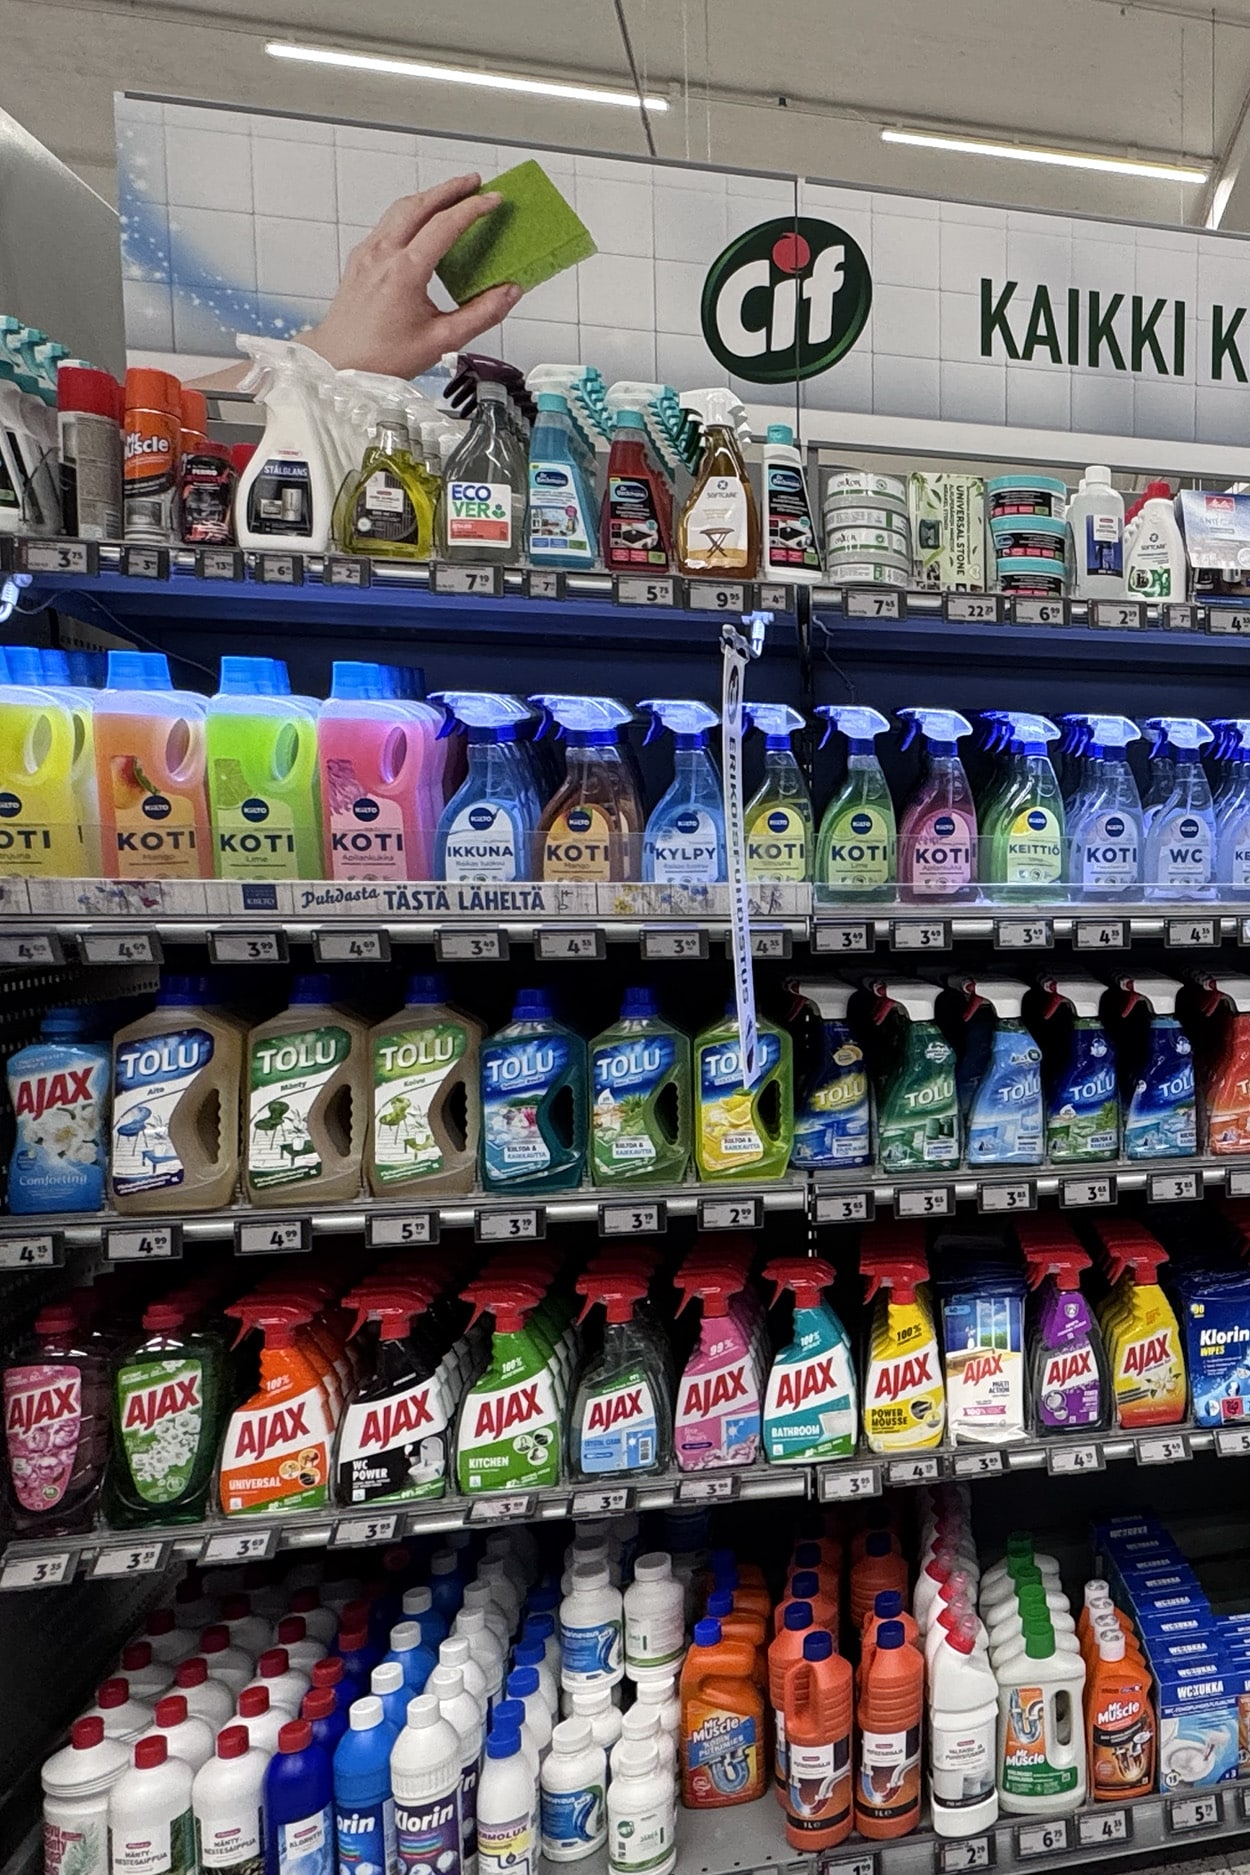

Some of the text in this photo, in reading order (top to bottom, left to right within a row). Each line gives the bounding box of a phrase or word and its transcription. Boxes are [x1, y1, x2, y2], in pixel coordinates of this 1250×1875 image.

[716, 240, 845, 357] Cif
[981, 278, 1185, 376] KAIKKI
[451, 485, 491, 500] ECO
[453, 502, 491, 518] VER
[955, 485, 966, 576] UNIVERSAL STONE
[0, 831, 51, 849] OTI
[118, 832, 196, 850] KOTI
[220, 834, 294, 852] KOTI
[332, 833, 403, 851] KOTI
[448, 846, 514, 858] IKKUNA
[547, 844, 610, 861] KOTI
[656, 847, 716, 861] KYLPY
[749, 843, 804, 859] KOTI
[832, 845, 888, 861] KOTI
[916, 848, 970, 864] KOTI
[1009, 843, 1060, 856] KEITTIÖ
[1087, 847, 1137, 862] KOTI
[1170, 849, 1203, 863] WC
[301, 886, 545, 911] Puhdasta TÄSTÄ LÄHELTÄ
[121, 1042, 199, 1078] TOLU
[256, 1039, 337, 1073] TOLU
[379, 1037, 455, 1071] TOLU
[705, 1045, 768, 1078] TOU
[487, 1049, 555, 1081] TOLU
[597, 1049, 661, 1081] TOLU
[16, 1066, 94, 1121] AJAX
[815, 1079, 865, 1108] TOLU
[905, 1079, 953, 1107] TOLU
[1070, 1073, 1115, 1100] TOLU
[19, 1172, 87, 1186] Comforting
[896, 1323, 922, 1341] 100%
[1200, 1326, 1250, 1347] Klorin
[709, 1340, 733, 1355] 99%
[1200, 1345, 1225, 1357] WIPES
[502, 1359, 523, 1373] 100%
[1047, 1351, 1092, 1386] AJAX
[266, 1374, 291, 1391] 100%
[776, 1358, 838, 1410] AJAX
[875, 1353, 932, 1400] AJAX
[684, 1365, 746, 1417] AJAX
[125, 1376, 200, 1431] AJAX
[474, 1383, 543, 1440] AJAX
[588, 1390, 644, 1432] AJAX
[359, 1389, 434, 1449] AJAX
[872, 1408, 903, 1418] POWER
[872, 1417, 908, 1426] MOUSSE
[234, 1403, 309, 1460] AJAX
[772, 1424, 820, 1438] BATHROOM
[352, 1460, 368, 1471] WC
[469, 1456, 509, 1469] KITCHEN
[352, 1468, 388, 1480] POWER
[229, 1477, 282, 1491] UNIVERSAL
[1097, 1701, 1140, 1725] Muscle
[693, 1717, 740, 1743] Muscle
